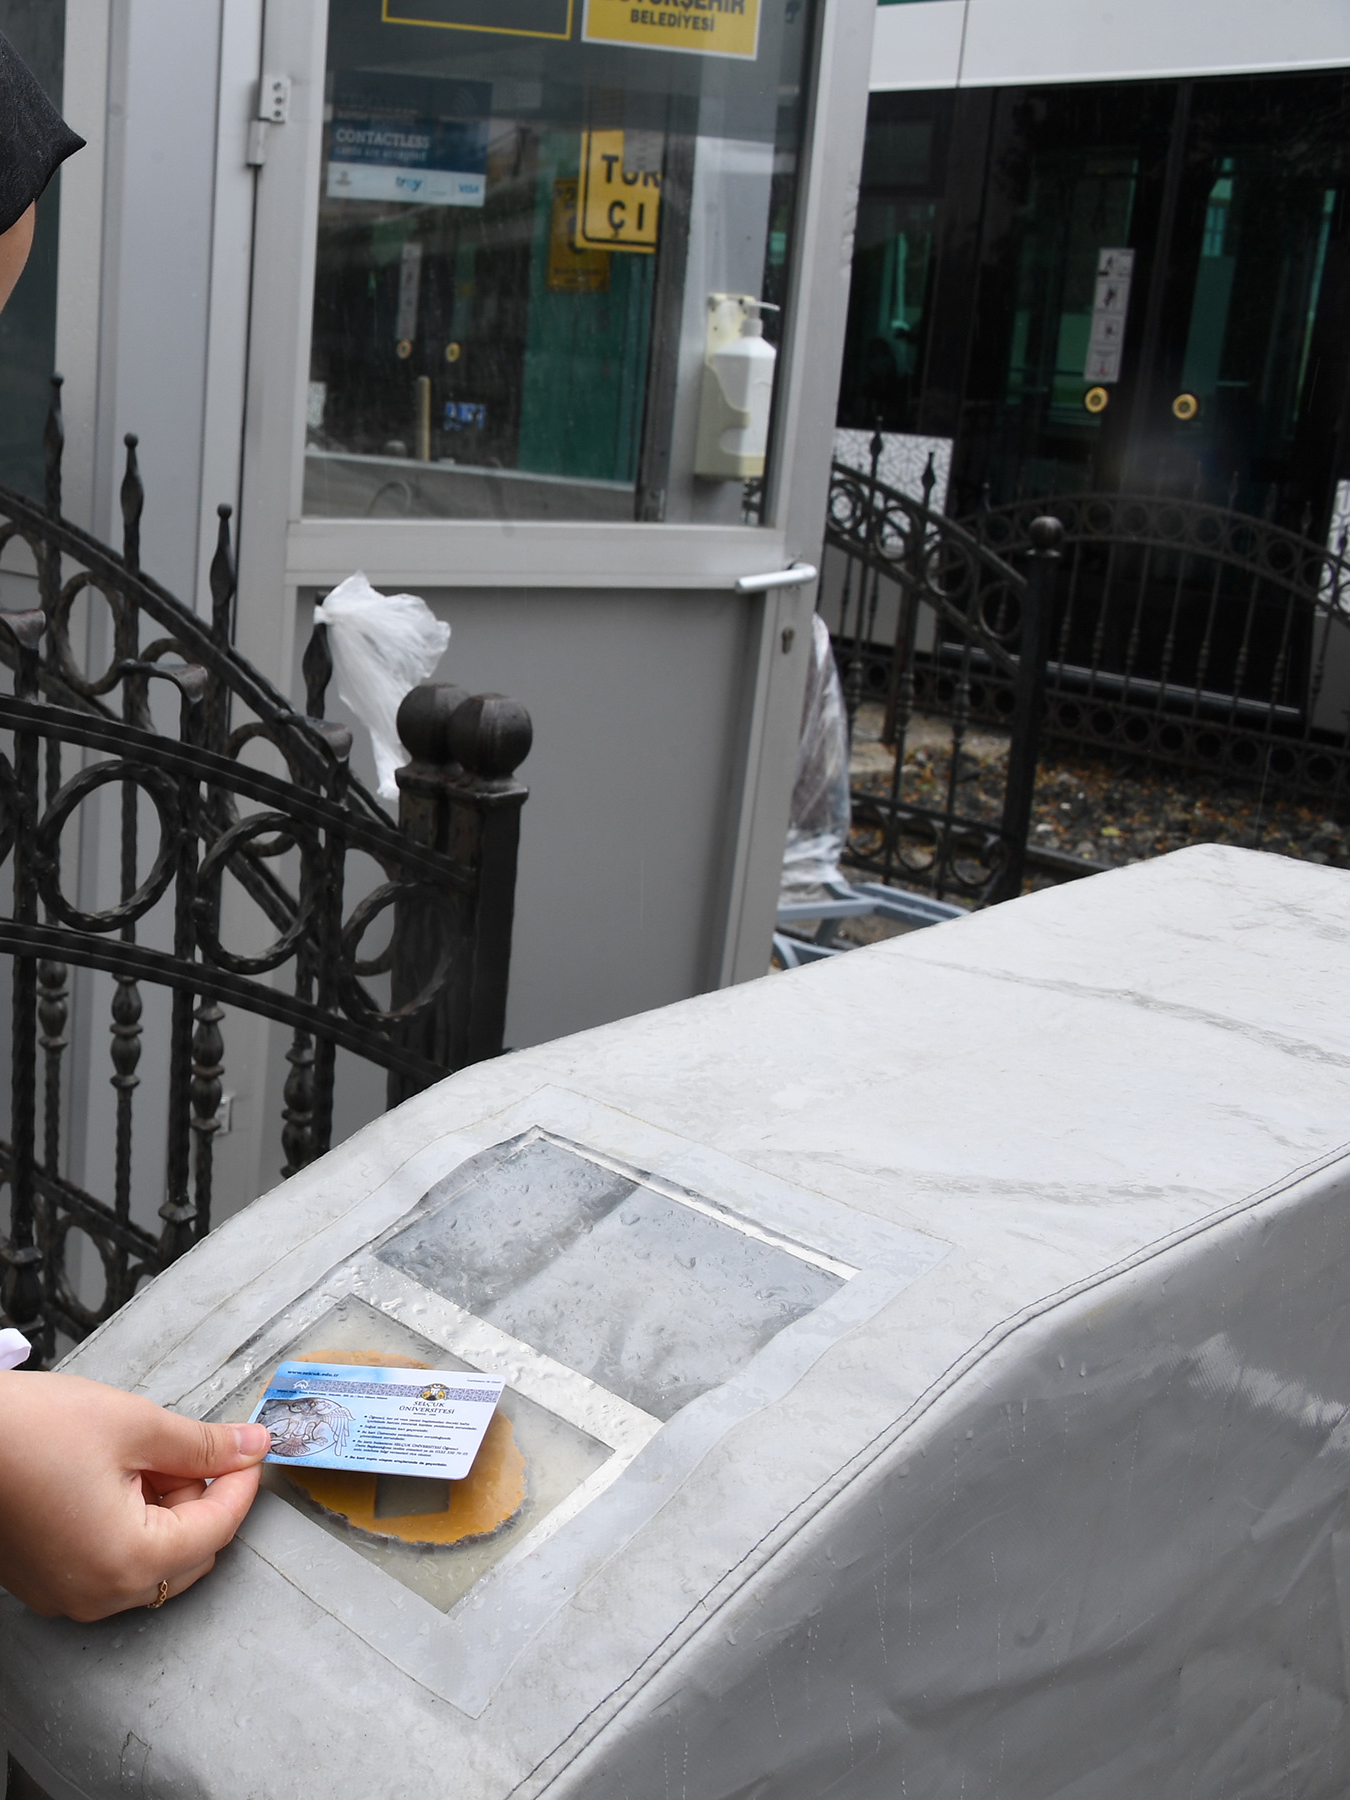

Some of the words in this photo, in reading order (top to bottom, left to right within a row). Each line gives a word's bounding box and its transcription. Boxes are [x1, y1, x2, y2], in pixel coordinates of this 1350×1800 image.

[631, 8, 715, 32] BELEDİYESİ
[336, 128, 430, 149] CONTACTLESS
[396, 176, 423, 193] troy
[458, 184, 480, 194] VISA
[399, 1405, 455, 1415] ÜNİVERSİTESİ
